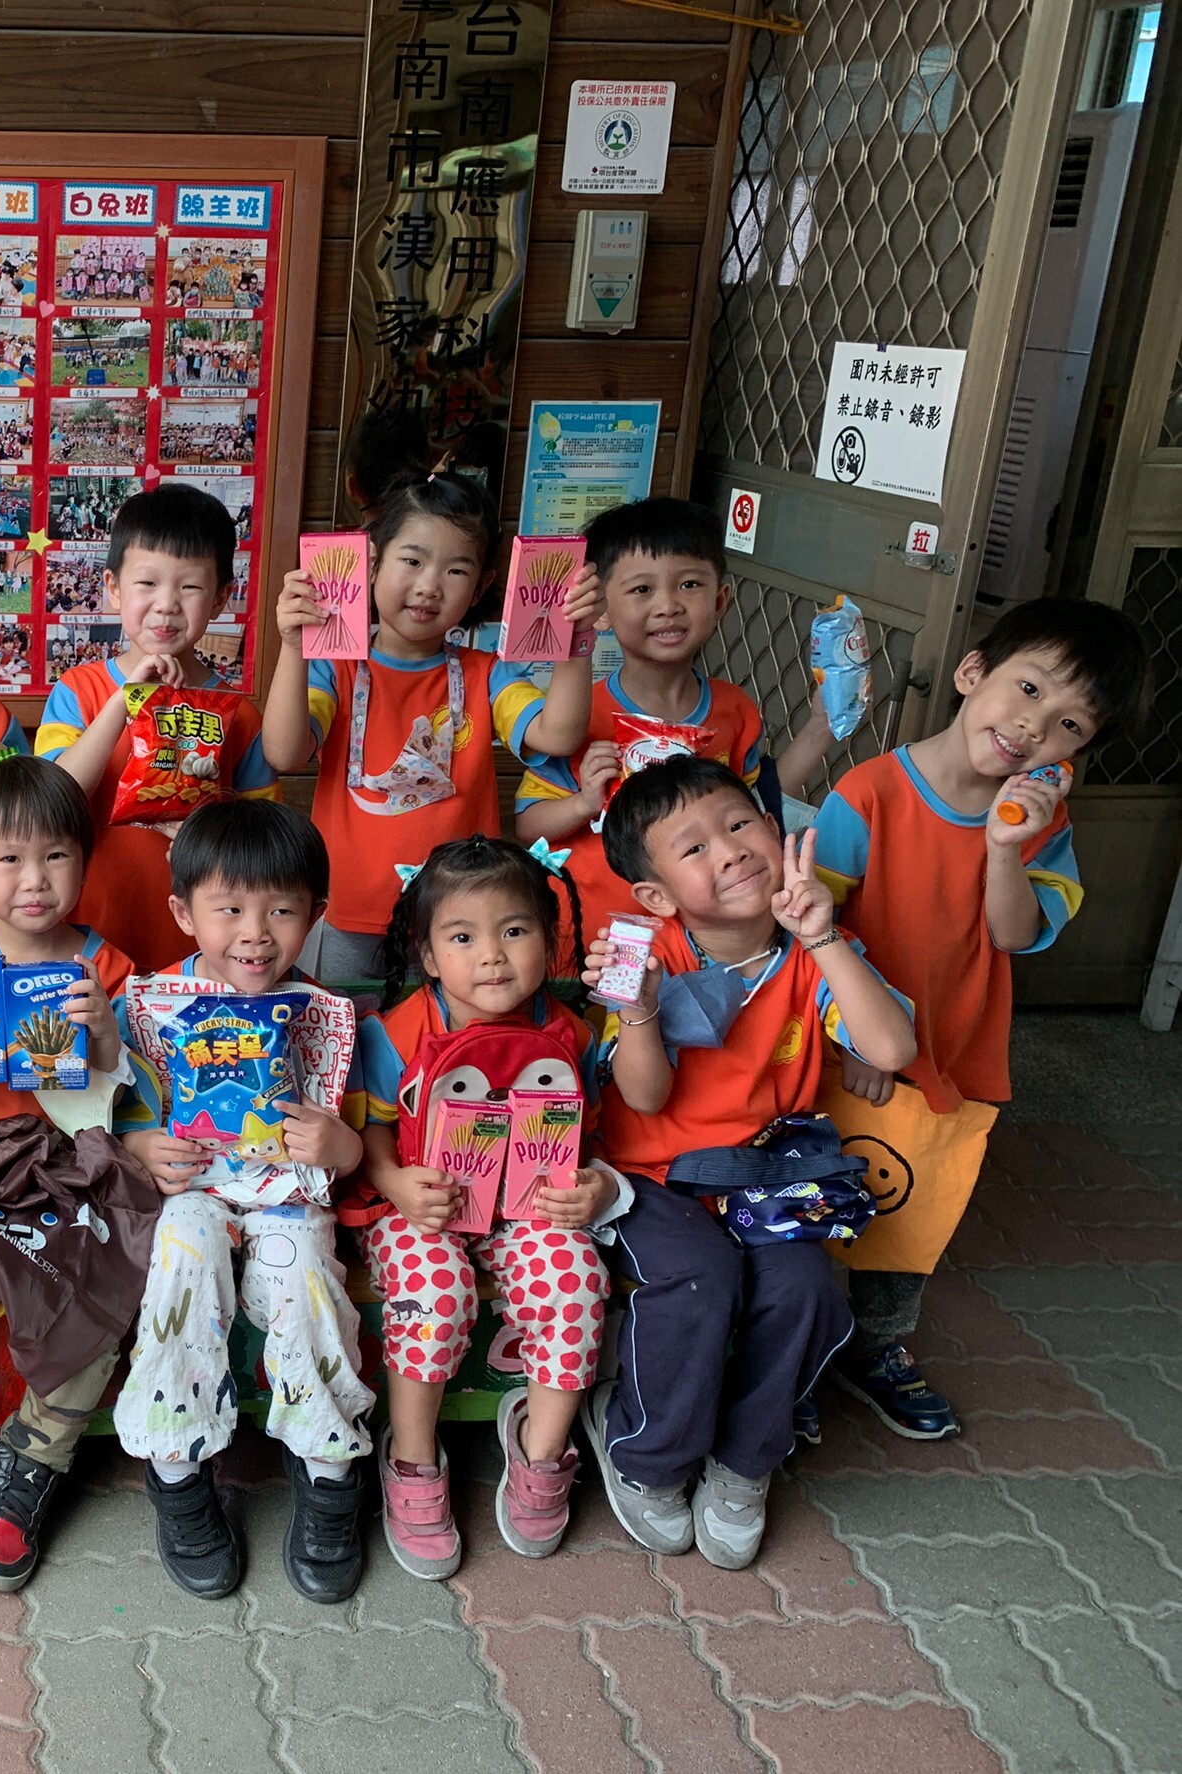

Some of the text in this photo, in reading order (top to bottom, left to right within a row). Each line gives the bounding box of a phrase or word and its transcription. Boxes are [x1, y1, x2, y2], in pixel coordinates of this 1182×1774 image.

[577, 96, 667, 106] 投保公共意外責任保險
[578, 84, 668, 95] 本場所已由教育部補助
[181, 194, 260, 220] 綿羊班
[367, 0, 455, 430] 南市漢家幼
[431, 0, 523, 478] 台南應用科技
[849, 358, 942, 389] 園內未經許可
[837, 393, 942, 430] 禁止錄音、錄影
[911, 528, 931, 553] 拉
[13, 973, 75, 993] OREO
[30, 992, 56, 1004] Wafer
[223, 1016, 254, 1031] STARS
[183, 1032, 270, 1070] 滿天星
